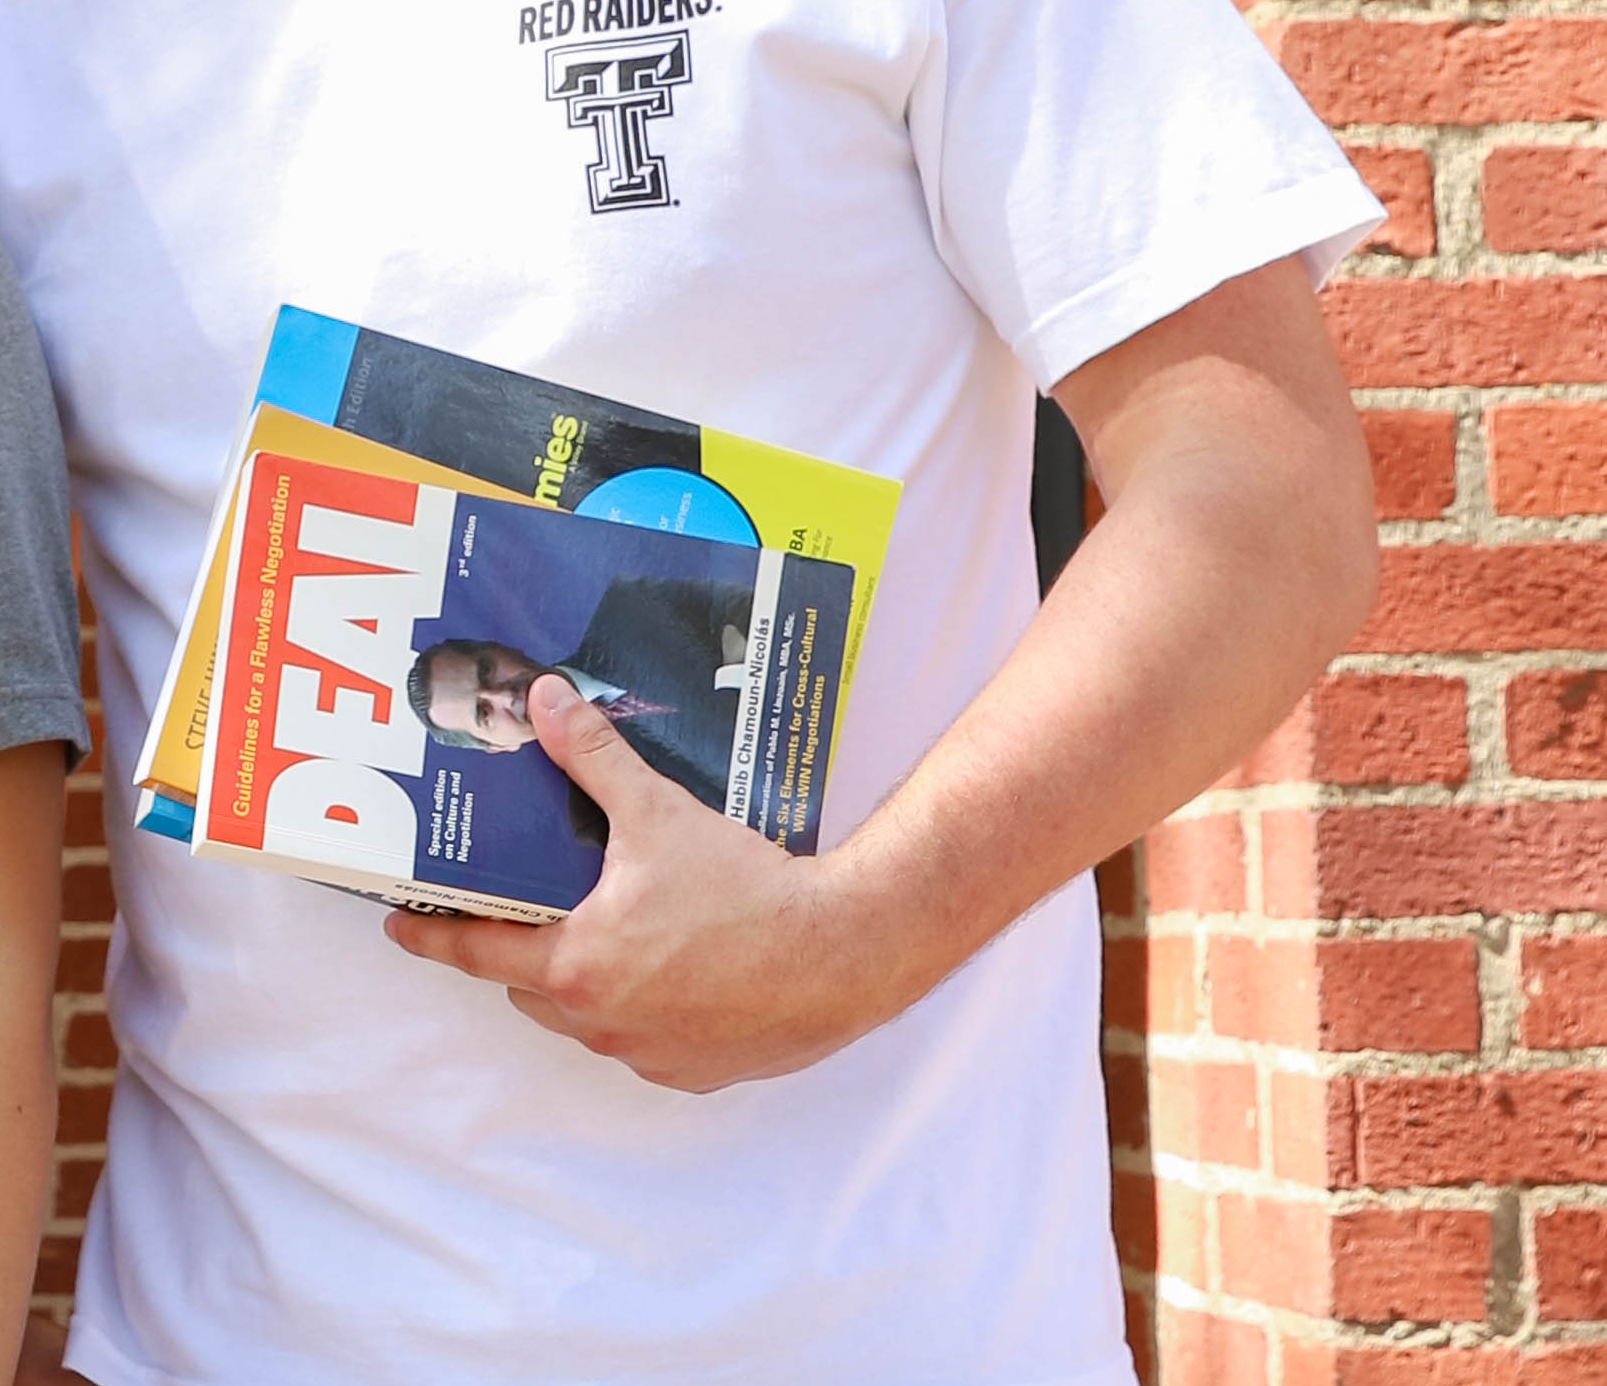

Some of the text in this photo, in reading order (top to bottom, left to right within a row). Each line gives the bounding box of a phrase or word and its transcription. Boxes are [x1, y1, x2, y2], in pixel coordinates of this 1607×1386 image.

[533, 414, 578, 507] mies
[464, 514, 478, 557] edition
[789, 528, 808, 551] BA
[233, 475, 291, 817] Guidelines for a Flawless Negotiation
[262, 483, 457, 880] DEAL
[793, 606, 818, 708] Cross-Cultural
[729, 617, 770, 819] Habib Chamoun-Nicolás
[789, 709, 803, 731] for
[793, 674, 826, 834] WIN-WIN Negotiations
[759, 772, 772, 836] ollaboration
[780, 733, 799, 798] Elements
[428, 769, 447, 857] Special edition
[444, 771, 461, 860] on Culture and
[456, 792, 474, 863] Negotiation
[777, 800, 789, 825] Six
